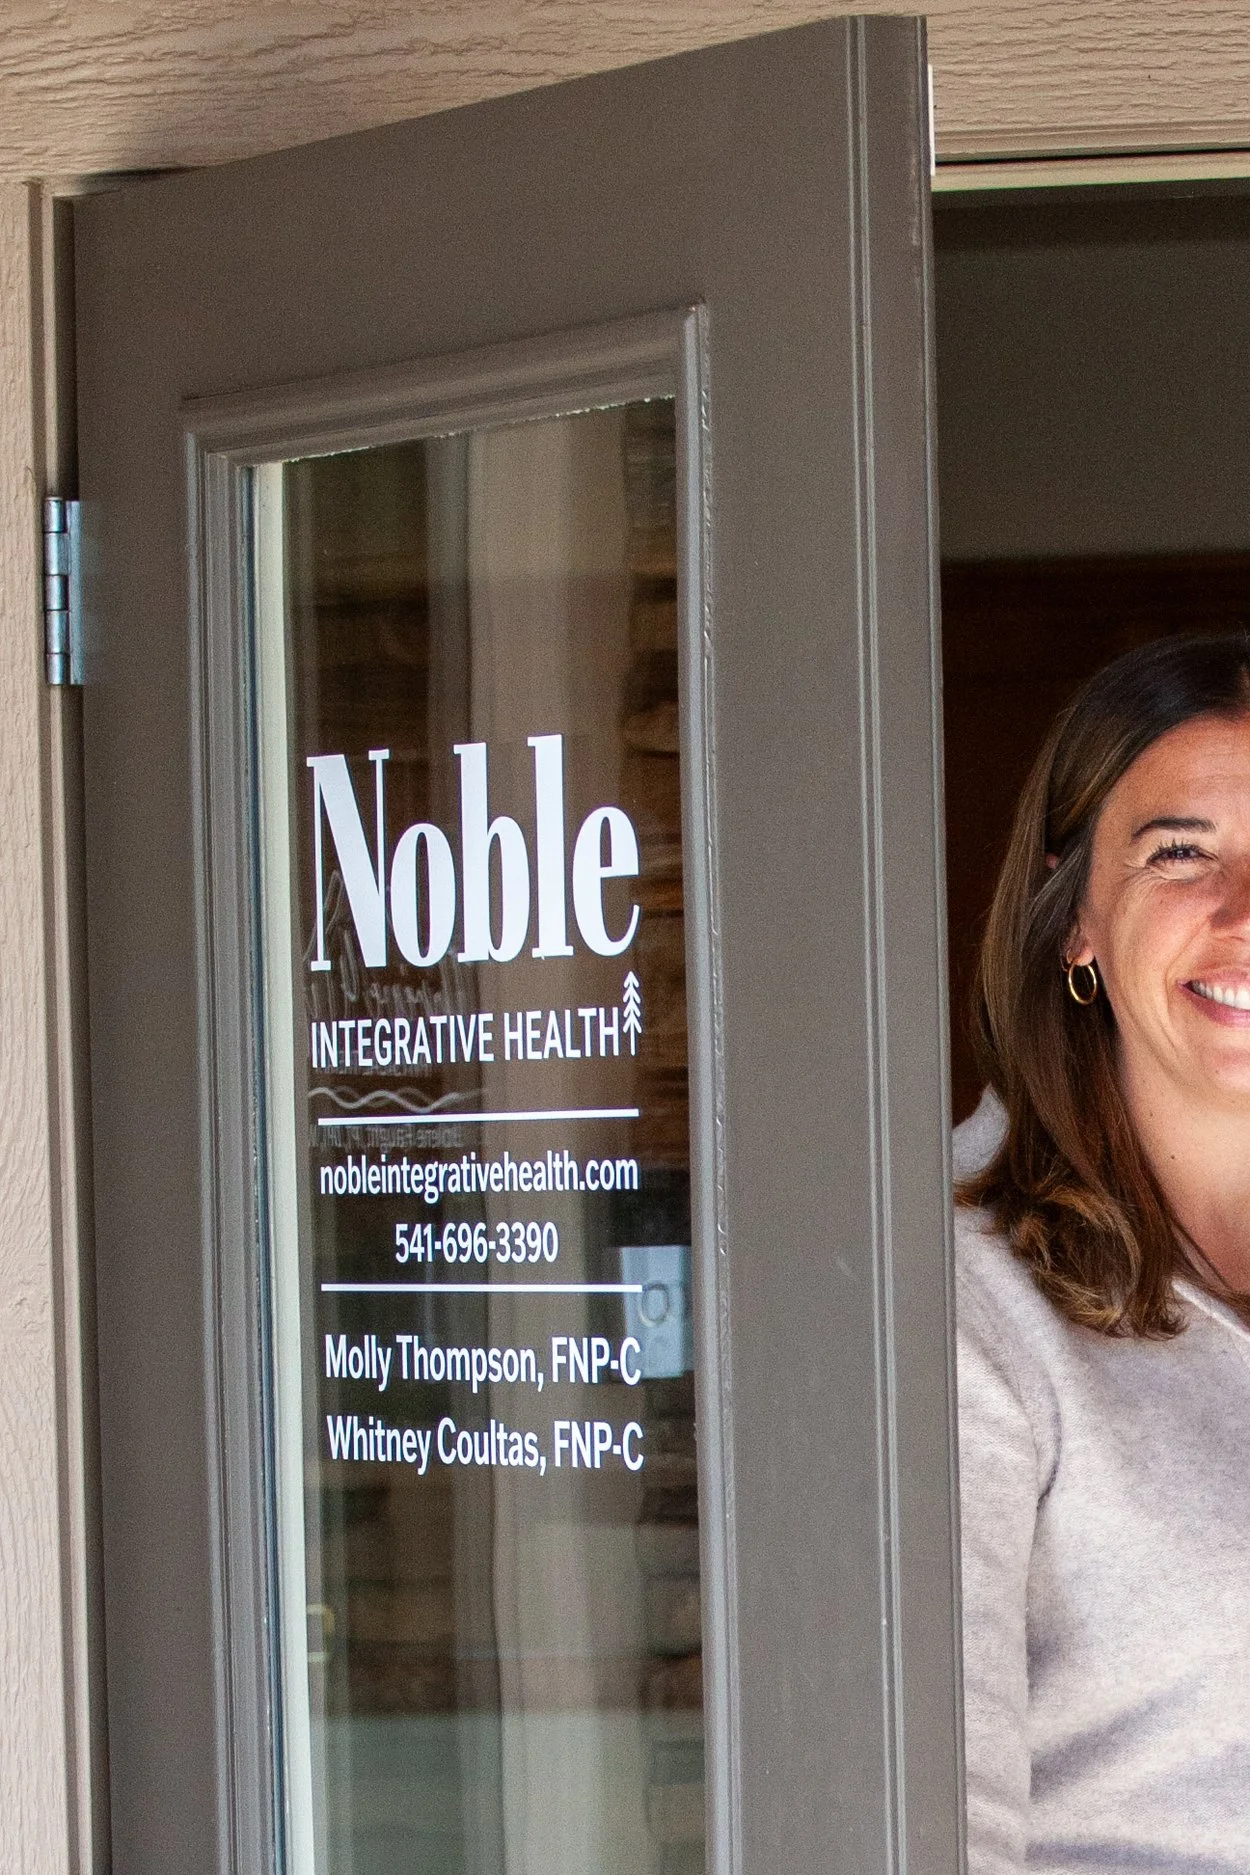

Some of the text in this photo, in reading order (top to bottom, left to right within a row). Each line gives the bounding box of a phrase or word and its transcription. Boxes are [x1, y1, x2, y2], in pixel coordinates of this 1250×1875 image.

[306, 733, 640, 971] Noble
[311, 1013, 494, 1068] INTEGRATIVE
[503, 1006, 619, 1060] HEALTH
[320, 1150, 639, 1203] nobleintegrativehealth.com
[395, 1221, 558, 1263] 541-696-3390
[325, 1334, 641, 1393] Molly Thompson, FNP-C
[327, 1415, 644, 1476] Whitney Coultas, FNP-C
